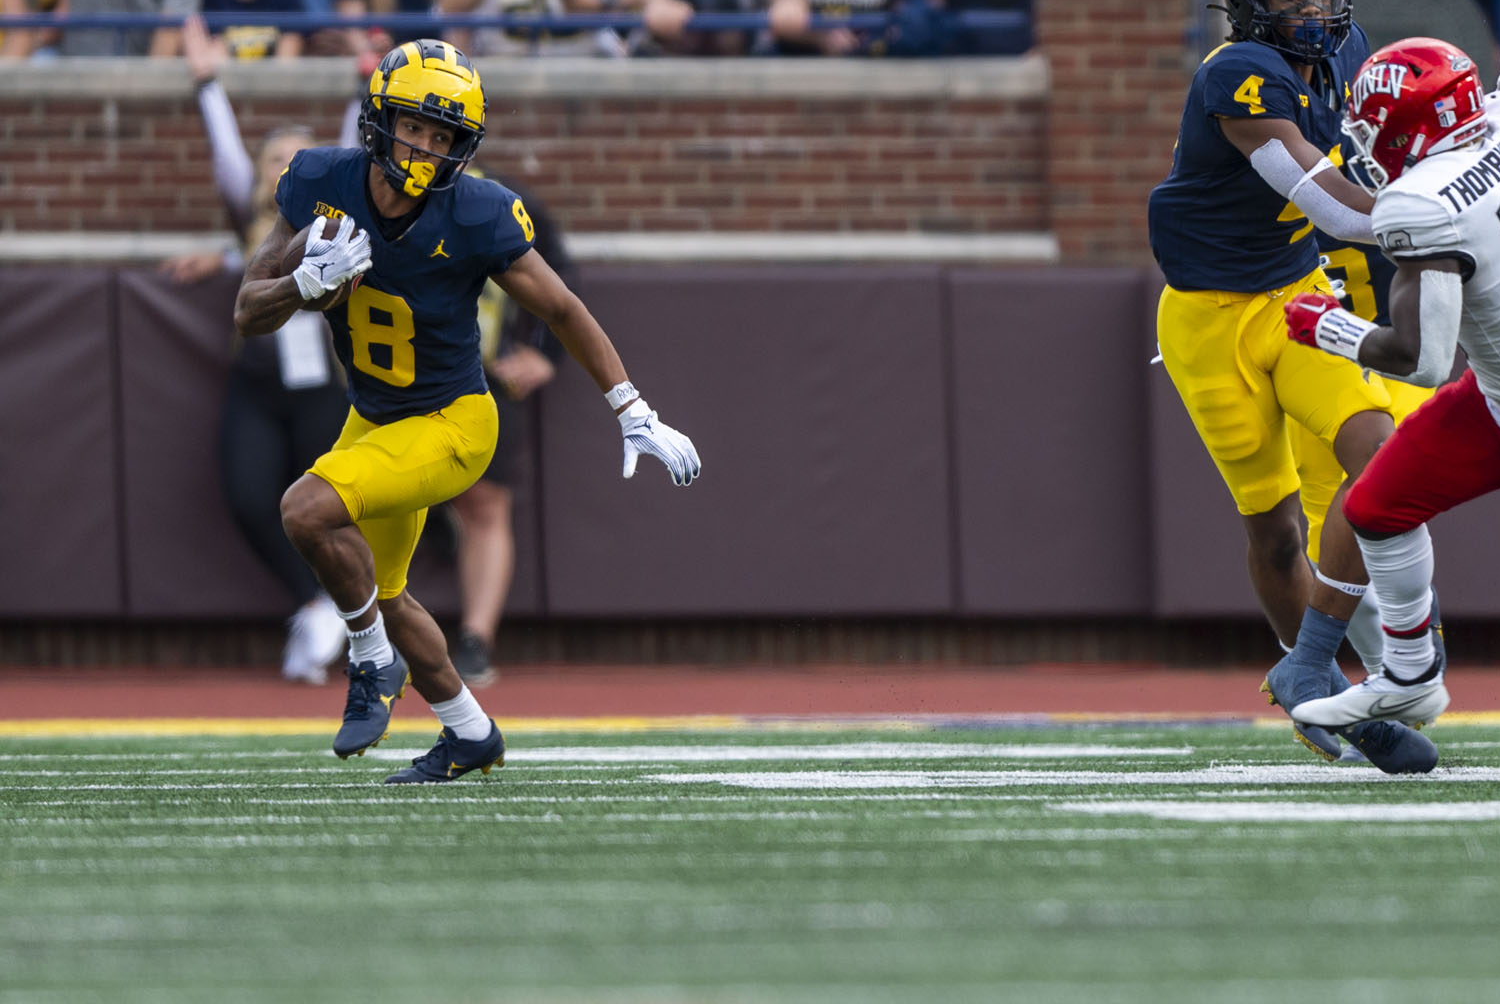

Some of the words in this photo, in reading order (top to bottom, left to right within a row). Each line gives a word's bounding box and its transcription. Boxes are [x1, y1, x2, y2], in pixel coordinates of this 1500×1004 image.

[1234, 75, 1266, 114] 4
[1352, 63, 1408, 115] UNLV
[512, 199, 535, 243] 8
[347, 285, 415, 388] 8
